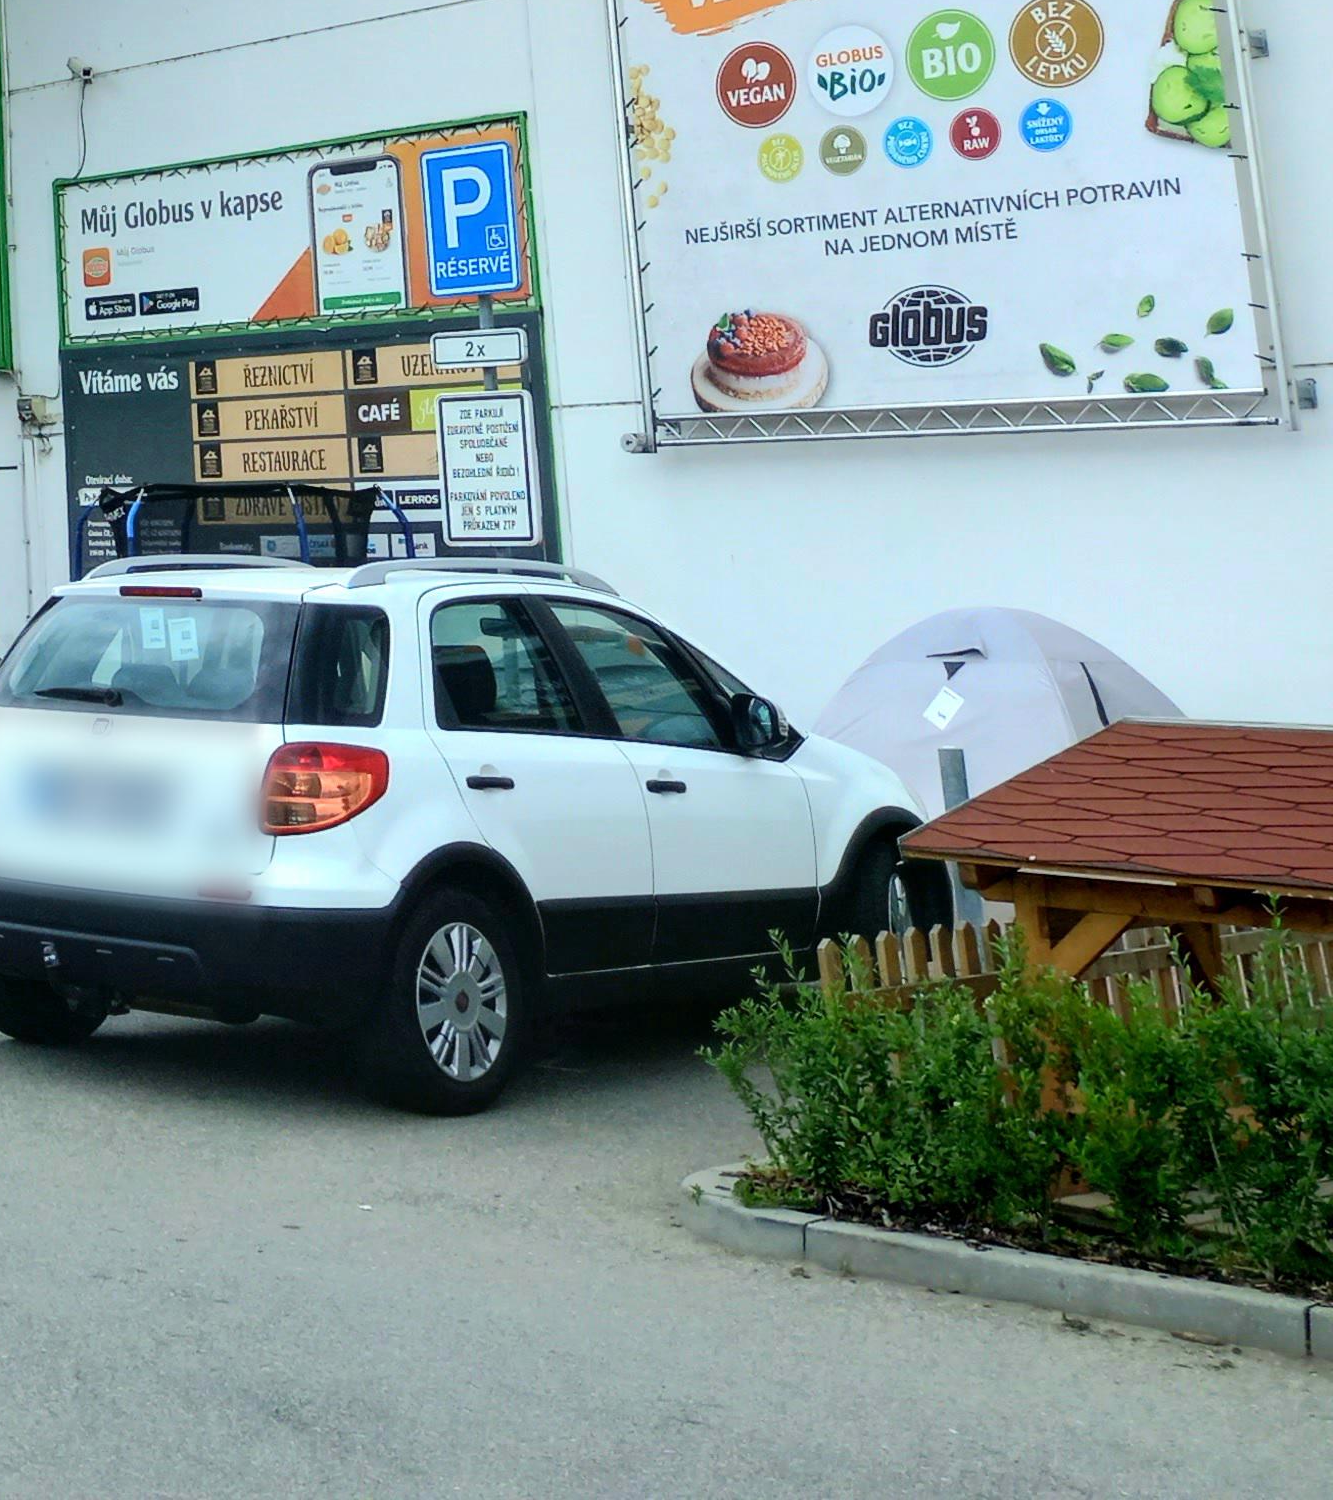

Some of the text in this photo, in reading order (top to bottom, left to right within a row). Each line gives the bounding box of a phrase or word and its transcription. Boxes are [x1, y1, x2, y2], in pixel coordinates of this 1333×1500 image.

[1029, 1, 1073, 26] BEZ
[815, 45, 884, 68] GLOBUS
[921, 41, 982, 80] BIO
[1024, 52, 1088, 82] LEPKU
[727, 82, 786, 108] VEGAN
[963, 137, 989, 151] RAW
[81, 190, 283, 237] Můj Globus v kapse
[441, 166, 491, 249] P
[685, 177, 1181, 244] NEJŠIRŠÍ SORTIMENT ALTERNATIVNÍCH POTRAVIN
[824, 218, 1018, 256] NA JEDNOM MÍSTĚ
[436, 252, 511, 279] RÉSERVÉ
[99, 304, 133, 316] App Store
[156, 297, 196, 311] Google Play
[78, 368, 142, 395] Vítáme
[146, 365, 179, 390] vás
[242, 358, 314, 388] ŘEZNICTVÍ
[244, 401, 319, 431] PEKAŘSTVÍ
[357, 398, 400, 423] CAFÉ
[242, 448, 327, 473] RESTAURACE
[475, 452, 494, 463] NEBO
[398, 494, 439, 505] LERROS
[490, 490, 526, 501] POVOLENO
[461, 505, 473, 516] JEN
[476, 506, 481, 516] S
[503, 519, 516, 530] ZTP
